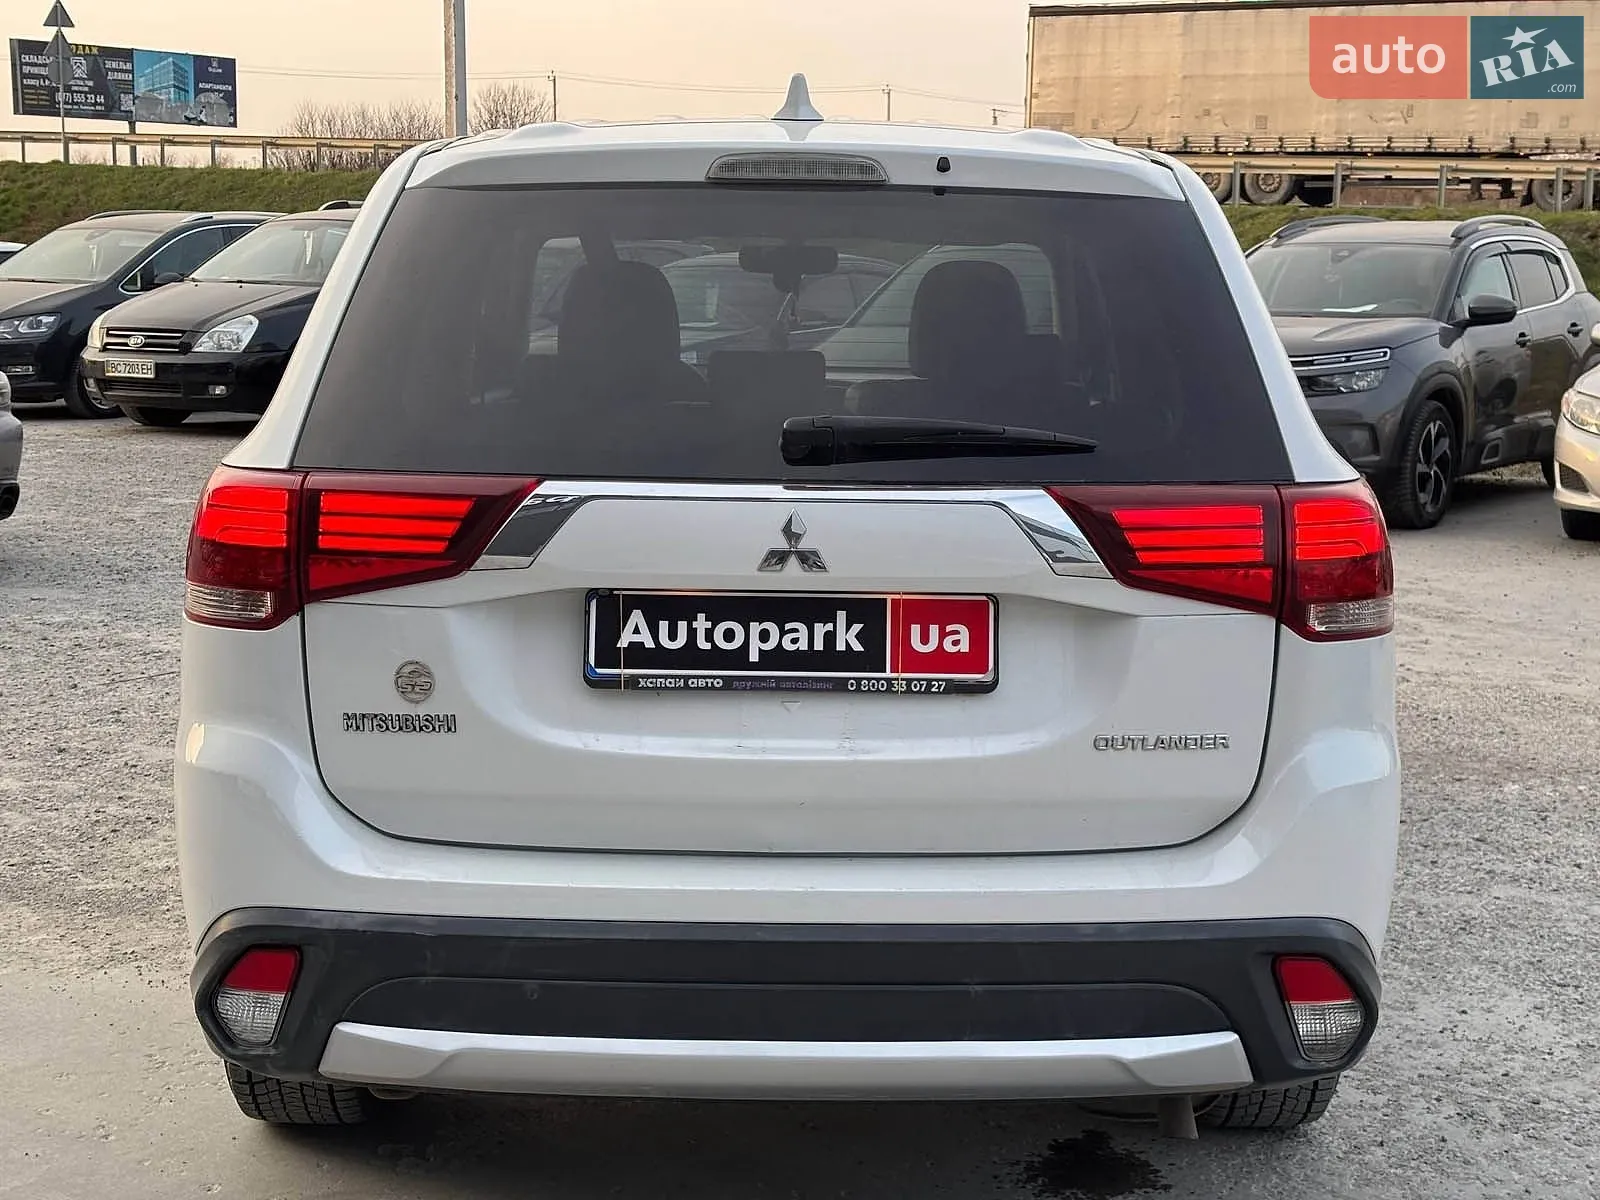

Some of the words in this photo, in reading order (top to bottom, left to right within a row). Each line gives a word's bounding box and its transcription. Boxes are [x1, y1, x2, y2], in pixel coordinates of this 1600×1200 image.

[616, 609, 865, 662] Autopark
[910, 622, 970, 654] ua
[687, 678, 723, 688] авто
[847, 680, 857, 691] 0
[860, 680, 887, 691] 800
[911, 681, 927, 692] 07
[931, 681, 946, 692] 27
[342, 712, 457, 733] MITSUBISHI
[1093, 734, 1230, 751] OUTLANDER
